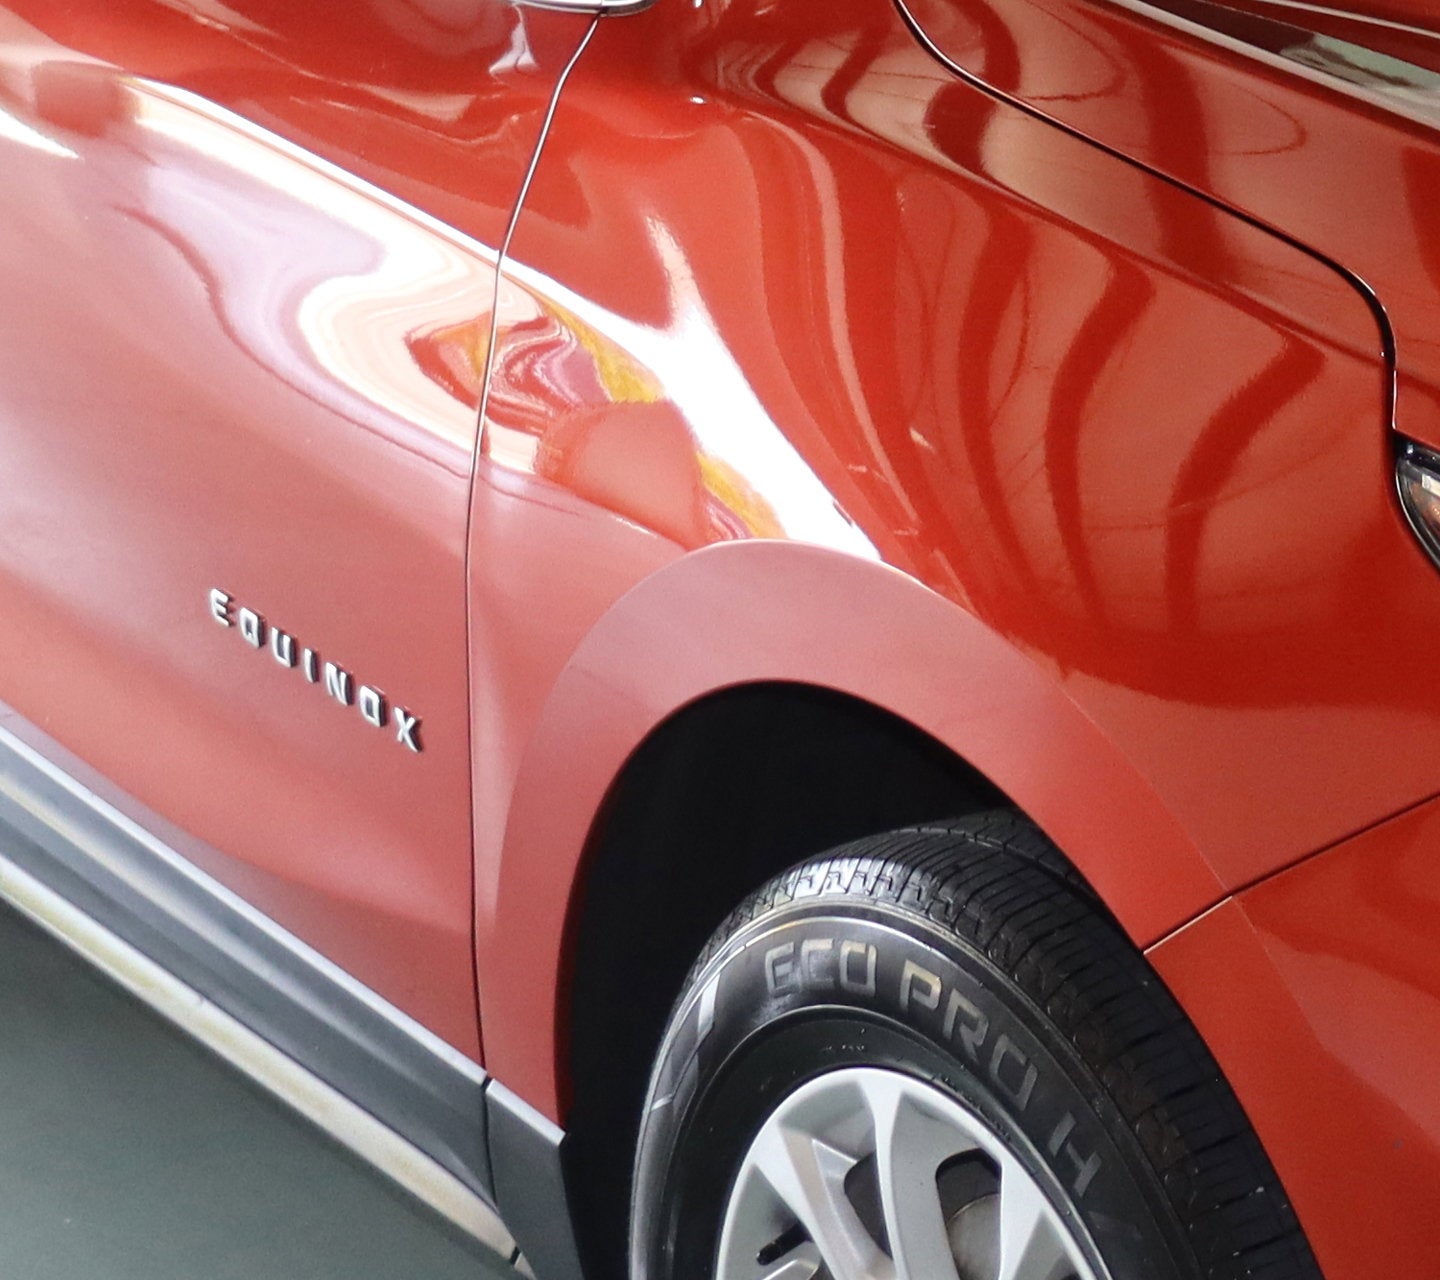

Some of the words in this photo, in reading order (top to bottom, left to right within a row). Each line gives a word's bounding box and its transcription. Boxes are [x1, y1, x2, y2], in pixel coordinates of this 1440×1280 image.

[208, 587, 423, 754] EQUINOX
[764, 936, 878, 1000] ECO
[898, 959, 1040, 1113] PRO
